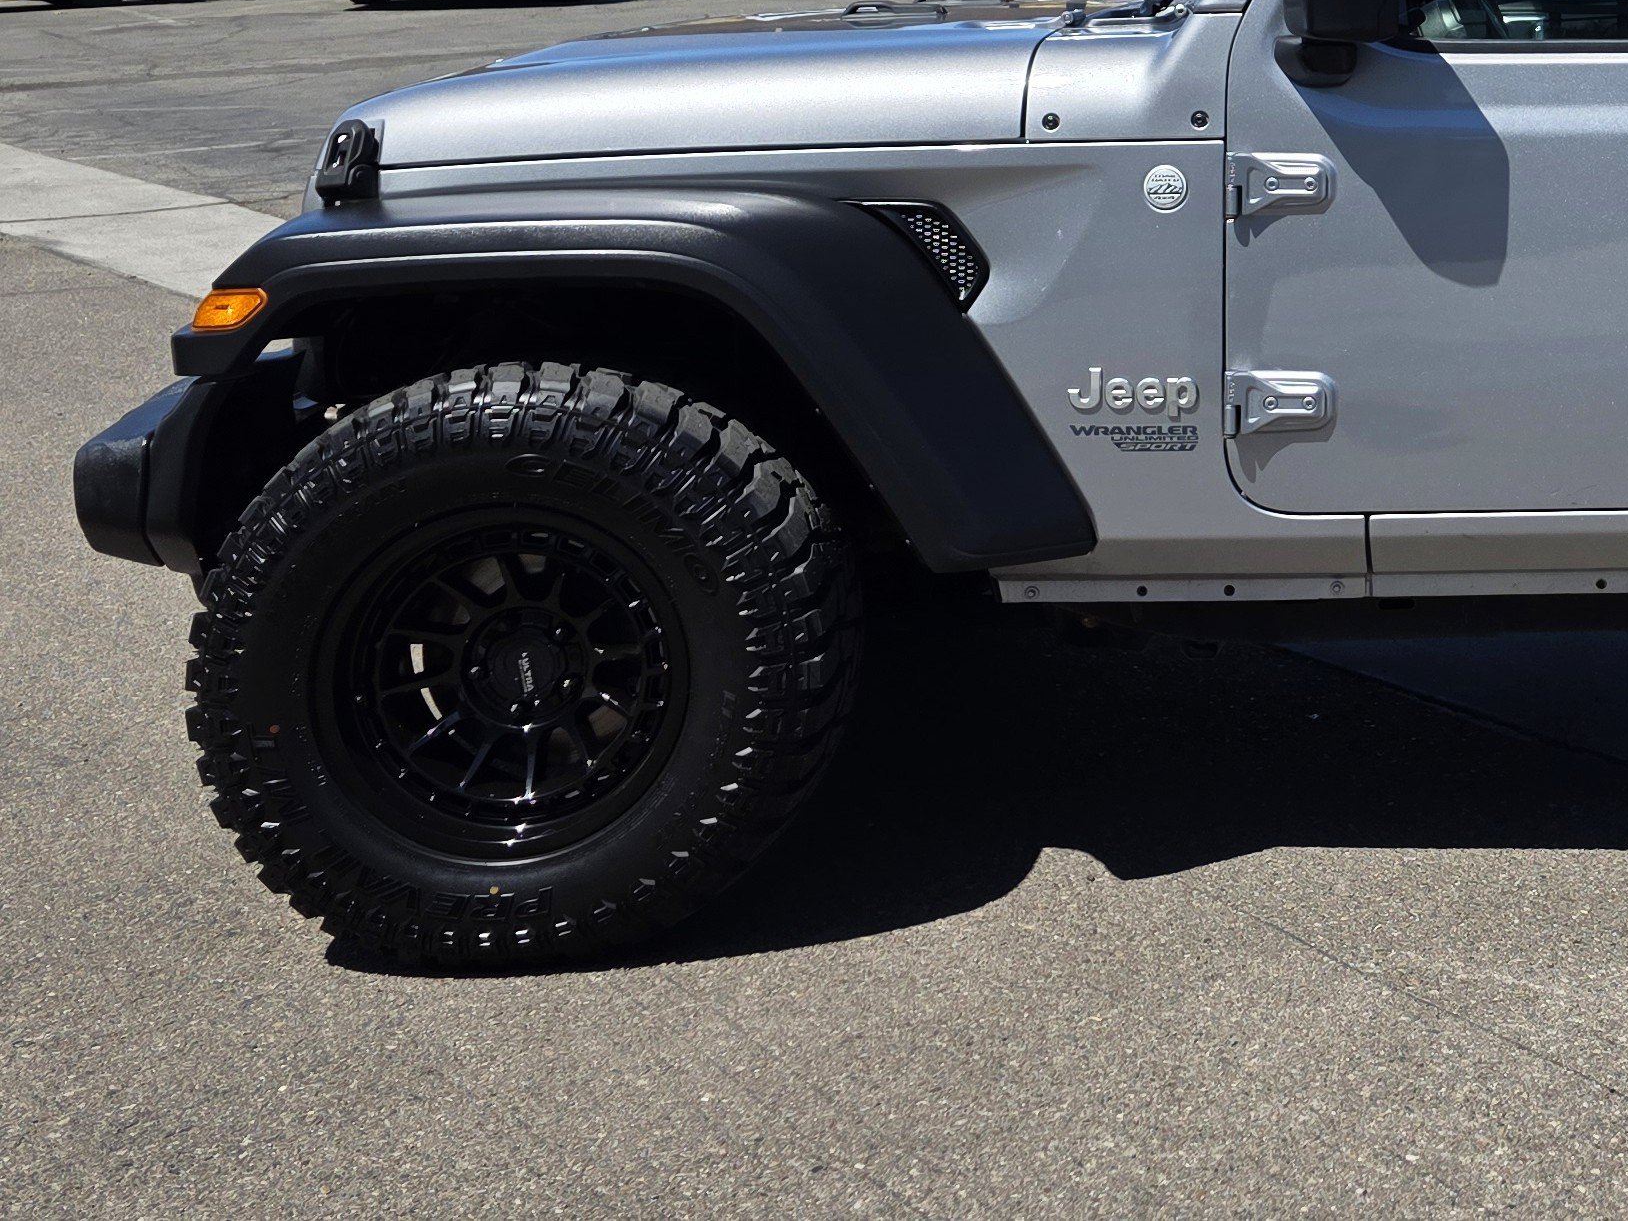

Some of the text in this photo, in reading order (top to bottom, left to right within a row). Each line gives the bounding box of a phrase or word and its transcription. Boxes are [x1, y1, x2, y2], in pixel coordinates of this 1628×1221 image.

[1067, 367, 1199, 419] Jeep
[1069, 424, 1199, 436] WRANGLER
[1119, 442, 1197, 451] SPORT
[504, 452, 719, 597] CELIMO
[521, 657, 535, 692] ULTRA
